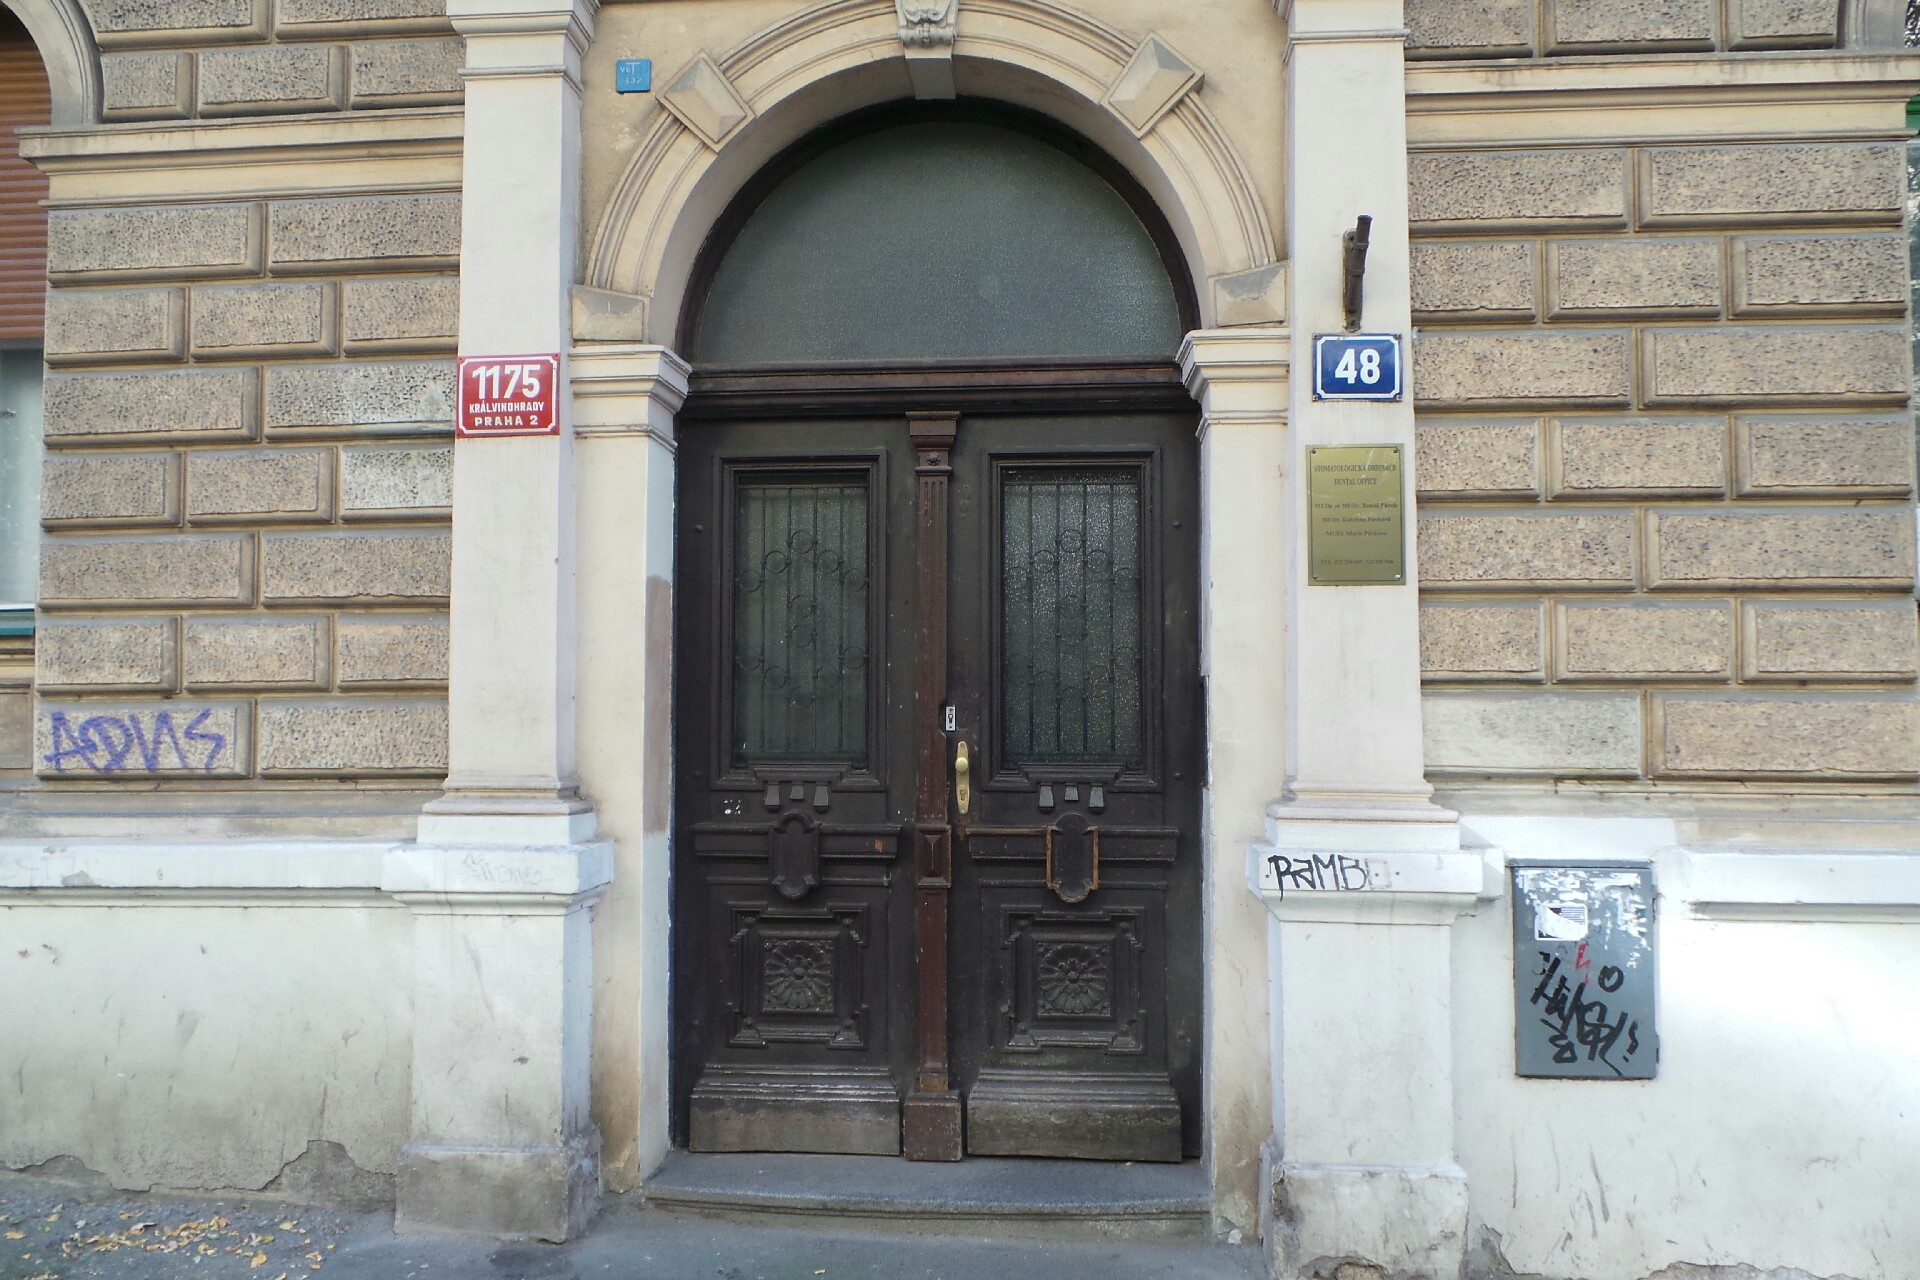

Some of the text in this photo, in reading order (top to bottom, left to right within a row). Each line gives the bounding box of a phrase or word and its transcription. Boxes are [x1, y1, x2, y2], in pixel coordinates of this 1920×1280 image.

[472, 365, 540, 399] 1175
[1334, 348, 1380, 384] 48
[474, 414, 539, 427] PRAHA 2
